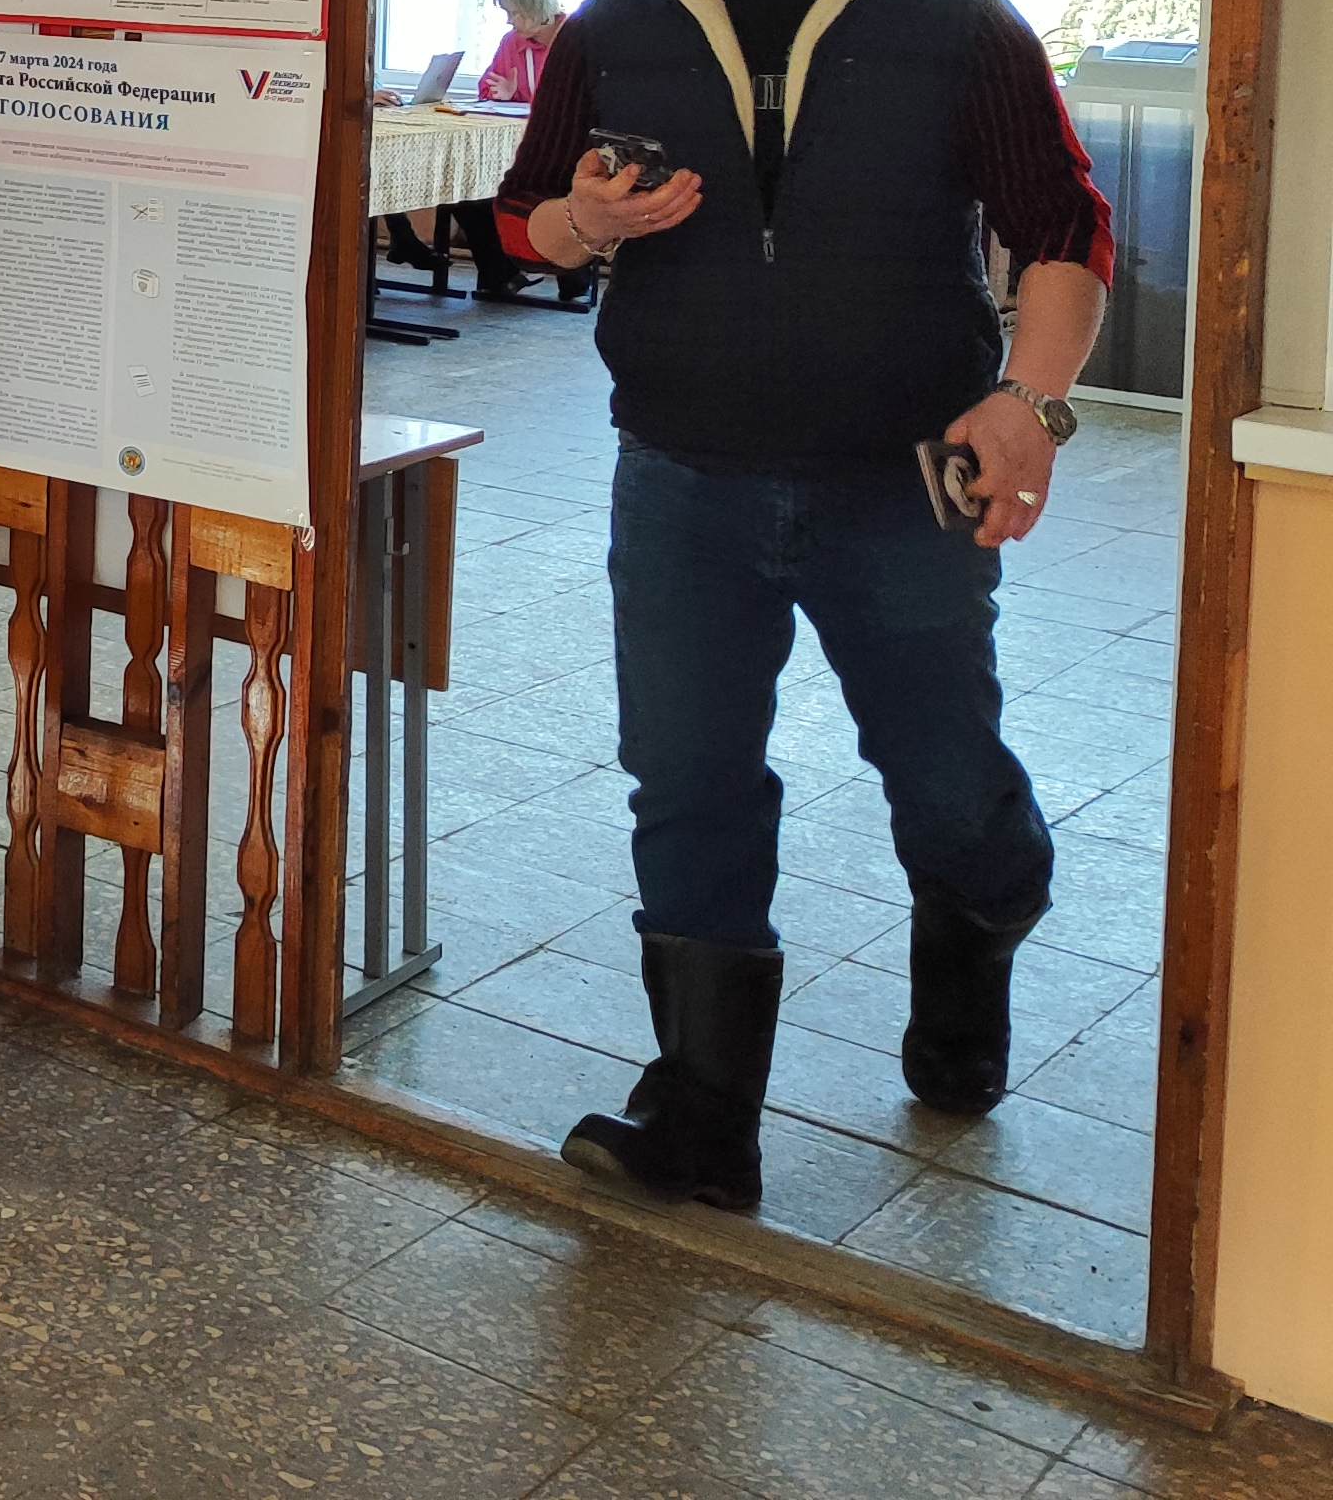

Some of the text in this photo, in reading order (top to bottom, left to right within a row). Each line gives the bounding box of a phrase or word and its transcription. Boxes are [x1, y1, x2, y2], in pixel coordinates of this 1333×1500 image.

[9, 54, 50, 69] марта
[52, 55, 83, 70] 2024
[87, 59, 118, 74] года
[19, 72, 113, 96] Российской
[117, 81, 216, 105] Федерации
